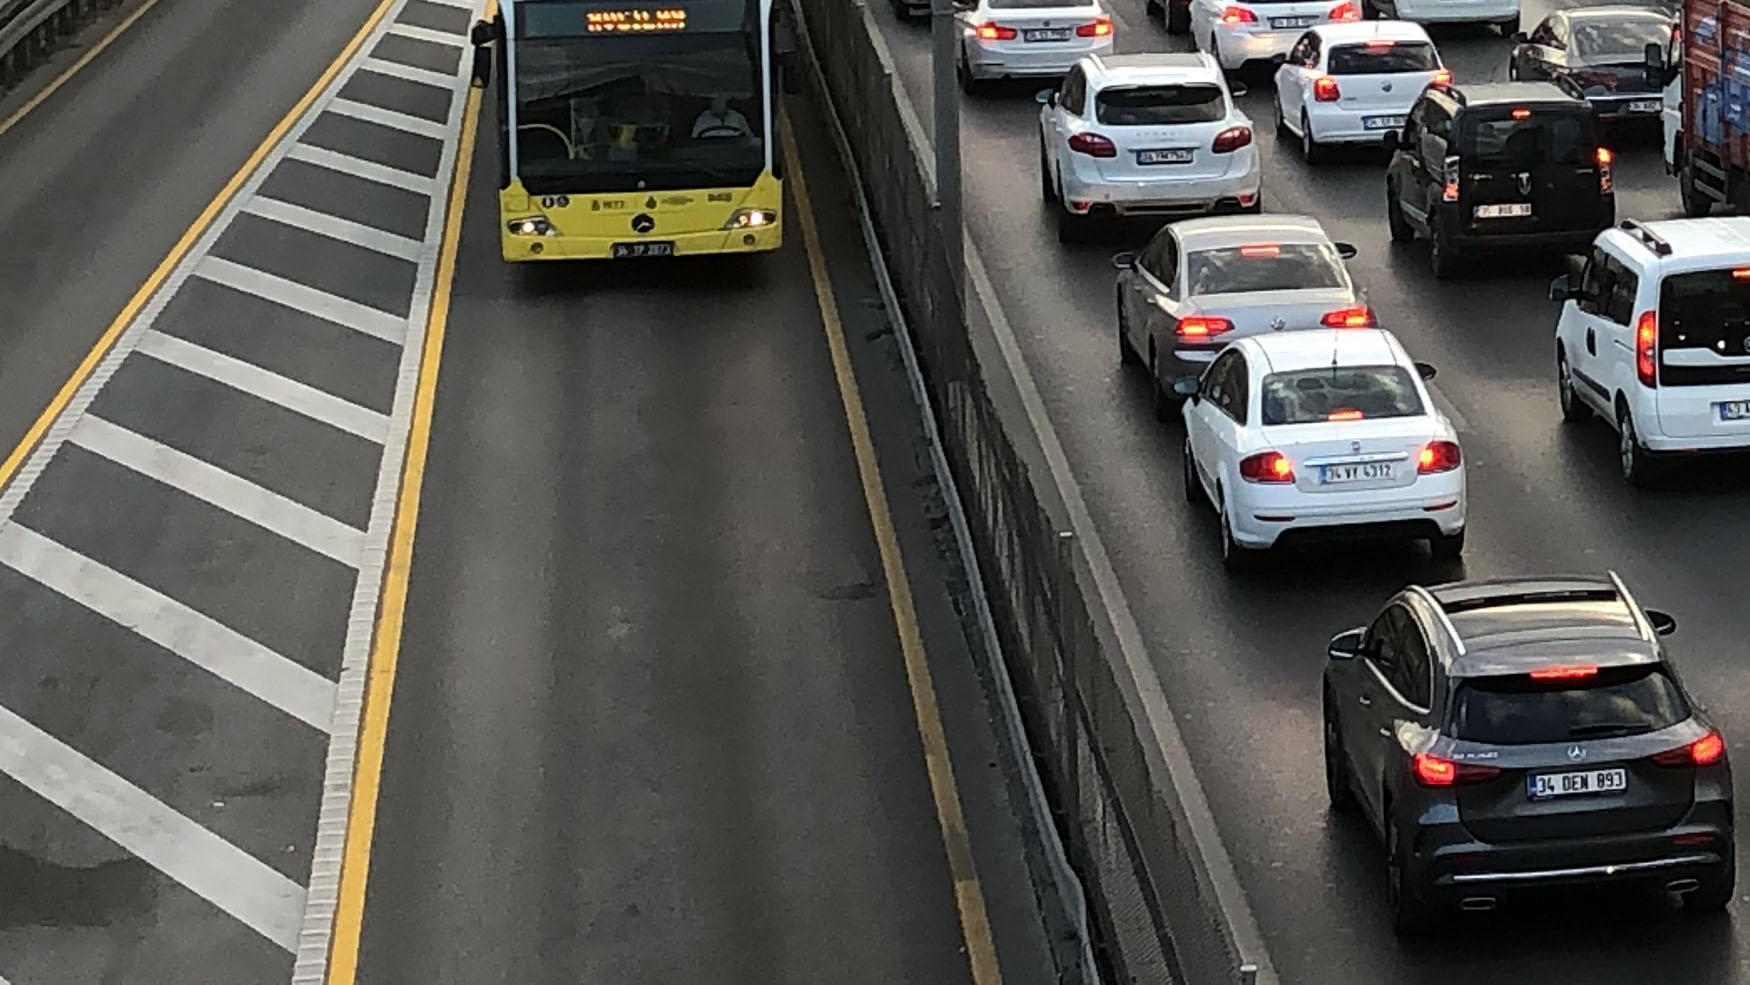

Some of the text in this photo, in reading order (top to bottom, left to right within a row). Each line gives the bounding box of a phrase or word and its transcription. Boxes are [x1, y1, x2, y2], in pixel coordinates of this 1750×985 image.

[1538, 771, 1623, 794] 34 DEN 893
